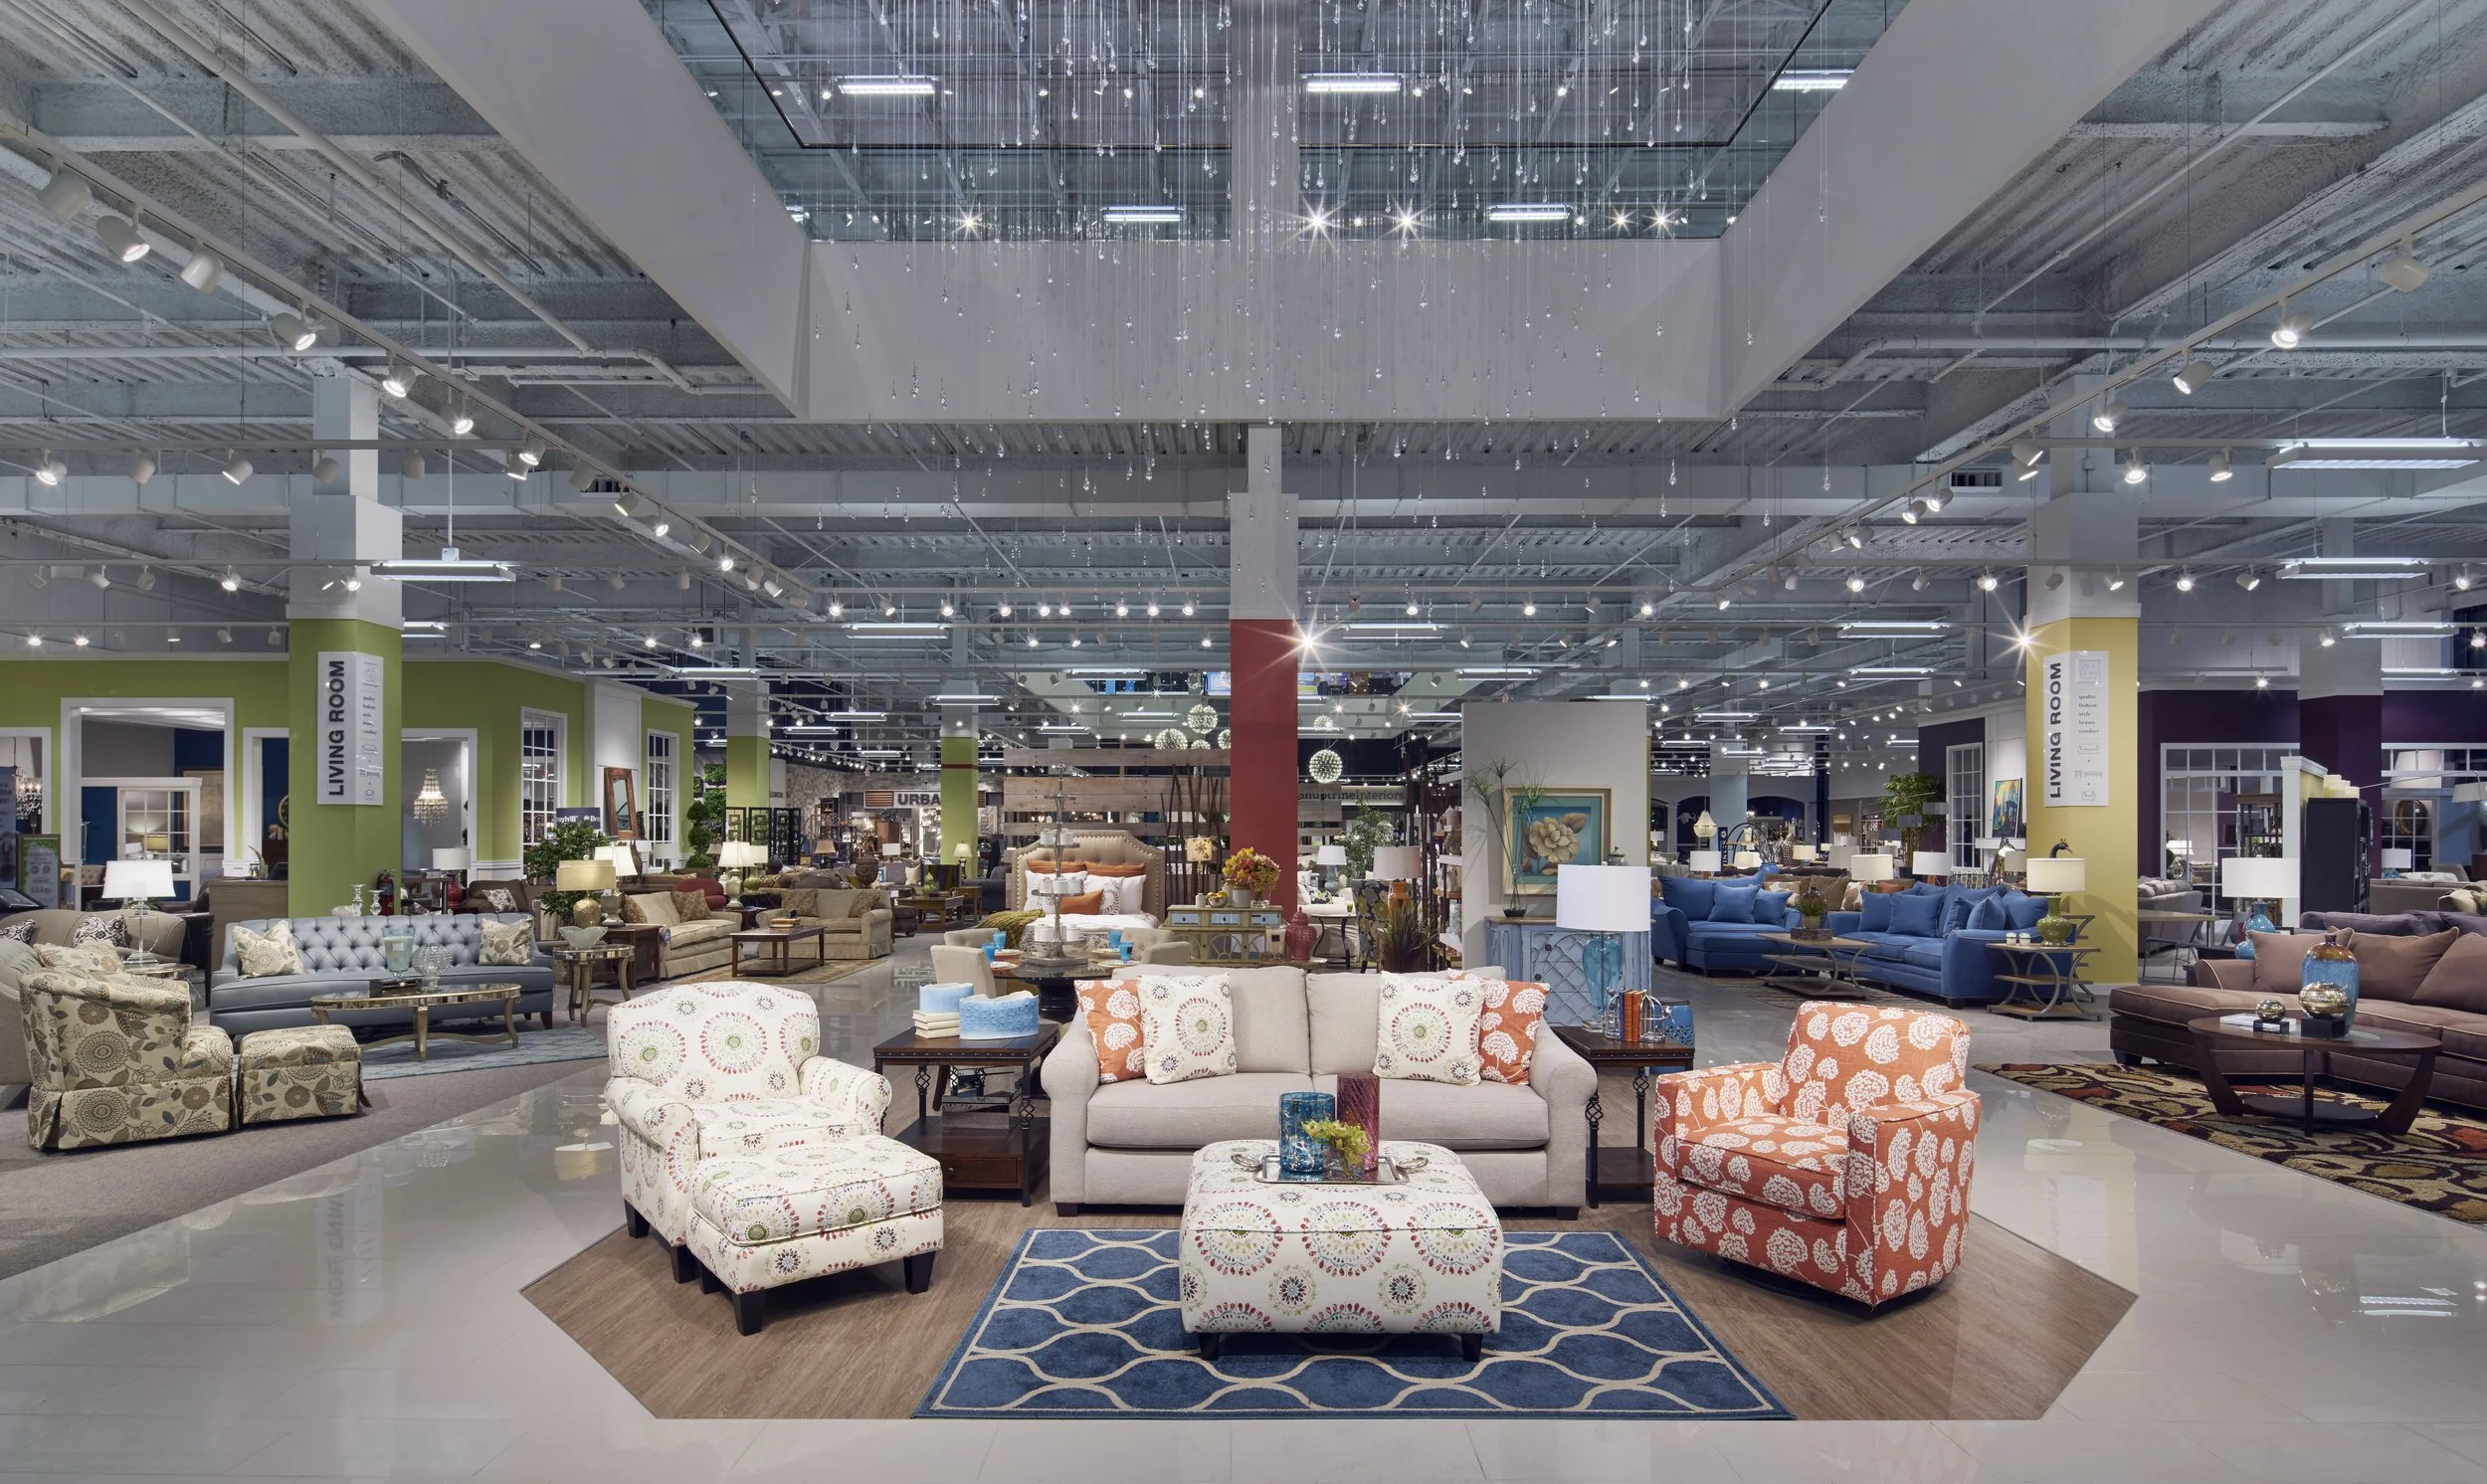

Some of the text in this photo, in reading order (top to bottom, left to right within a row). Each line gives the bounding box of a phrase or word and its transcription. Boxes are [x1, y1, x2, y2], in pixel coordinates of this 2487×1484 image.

[328, 660, 345, 796] LIVING ROOM
[2049, 662, 2061, 798] LIVING ROOM
[897, 793, 941, 806] URBA
